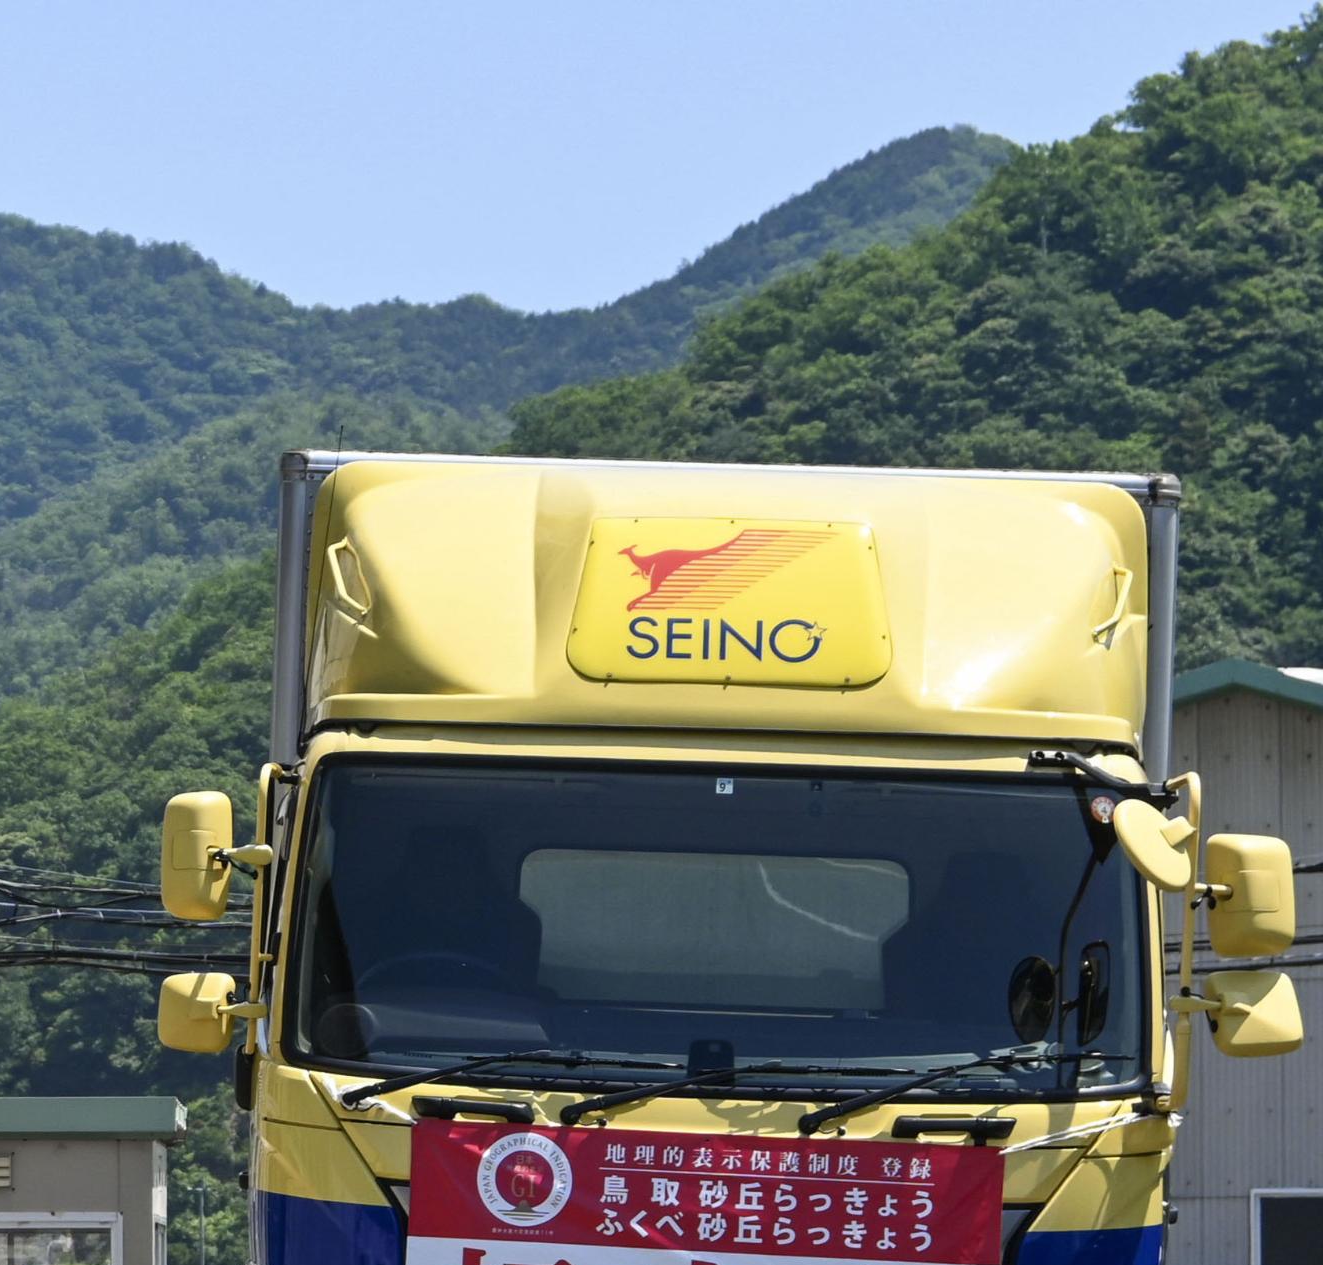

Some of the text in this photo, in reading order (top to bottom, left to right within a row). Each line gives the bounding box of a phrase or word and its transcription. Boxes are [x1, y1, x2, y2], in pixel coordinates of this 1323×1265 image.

[626, 616, 826, 663] SEINO
[482, 1136, 569, 1208] JAPAN GEOGRAPHICAL INDICATION
[604, 1143, 932, 1181] 地理的表示保護制度 登録
[511, 1174, 536, 1198] GI
[598, 1174, 935, 1219] 鳥取砂丘らっきょう
[595, 1208, 933, 1253] ふくべ砂丘らっきょう
